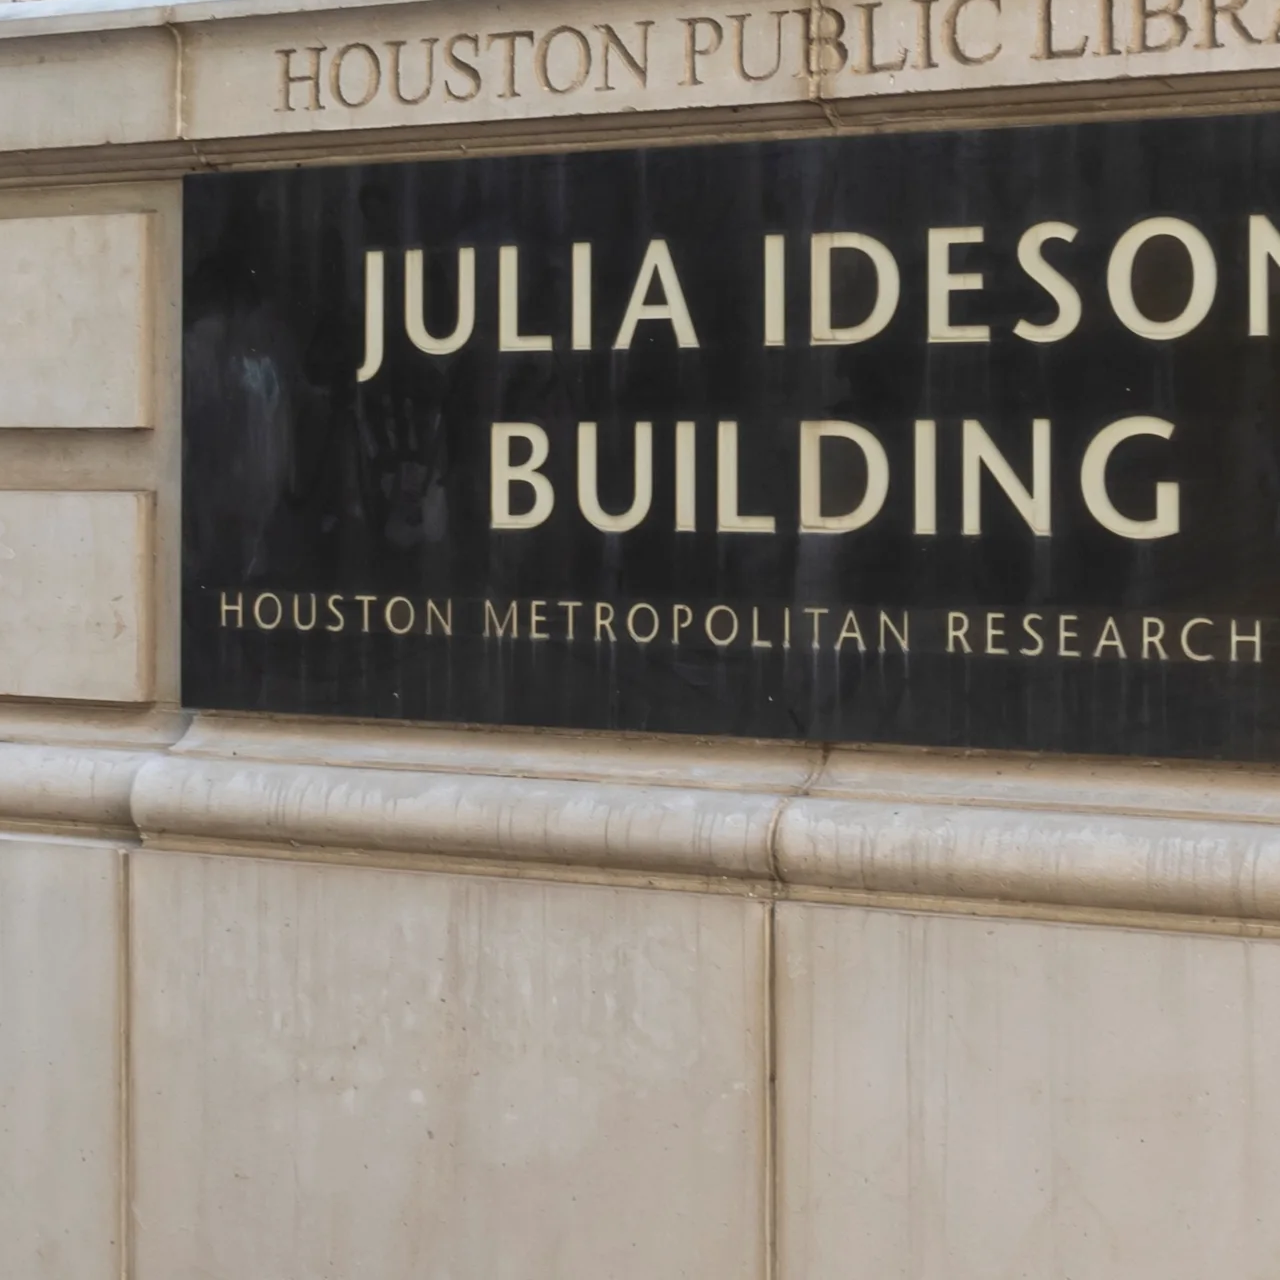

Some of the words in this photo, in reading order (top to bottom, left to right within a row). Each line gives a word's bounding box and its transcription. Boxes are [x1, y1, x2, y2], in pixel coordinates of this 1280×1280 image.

[275, 20, 654, 112] HOUSTON
[357, 239, 700, 382] JULIA
[490, 416, 1179, 540] BUILDING
[220, 592, 453, 637] HOUSTON
[483, 599, 910, 653] METROPOLITAN
[946, 612, 1262, 662] RESEARCH
